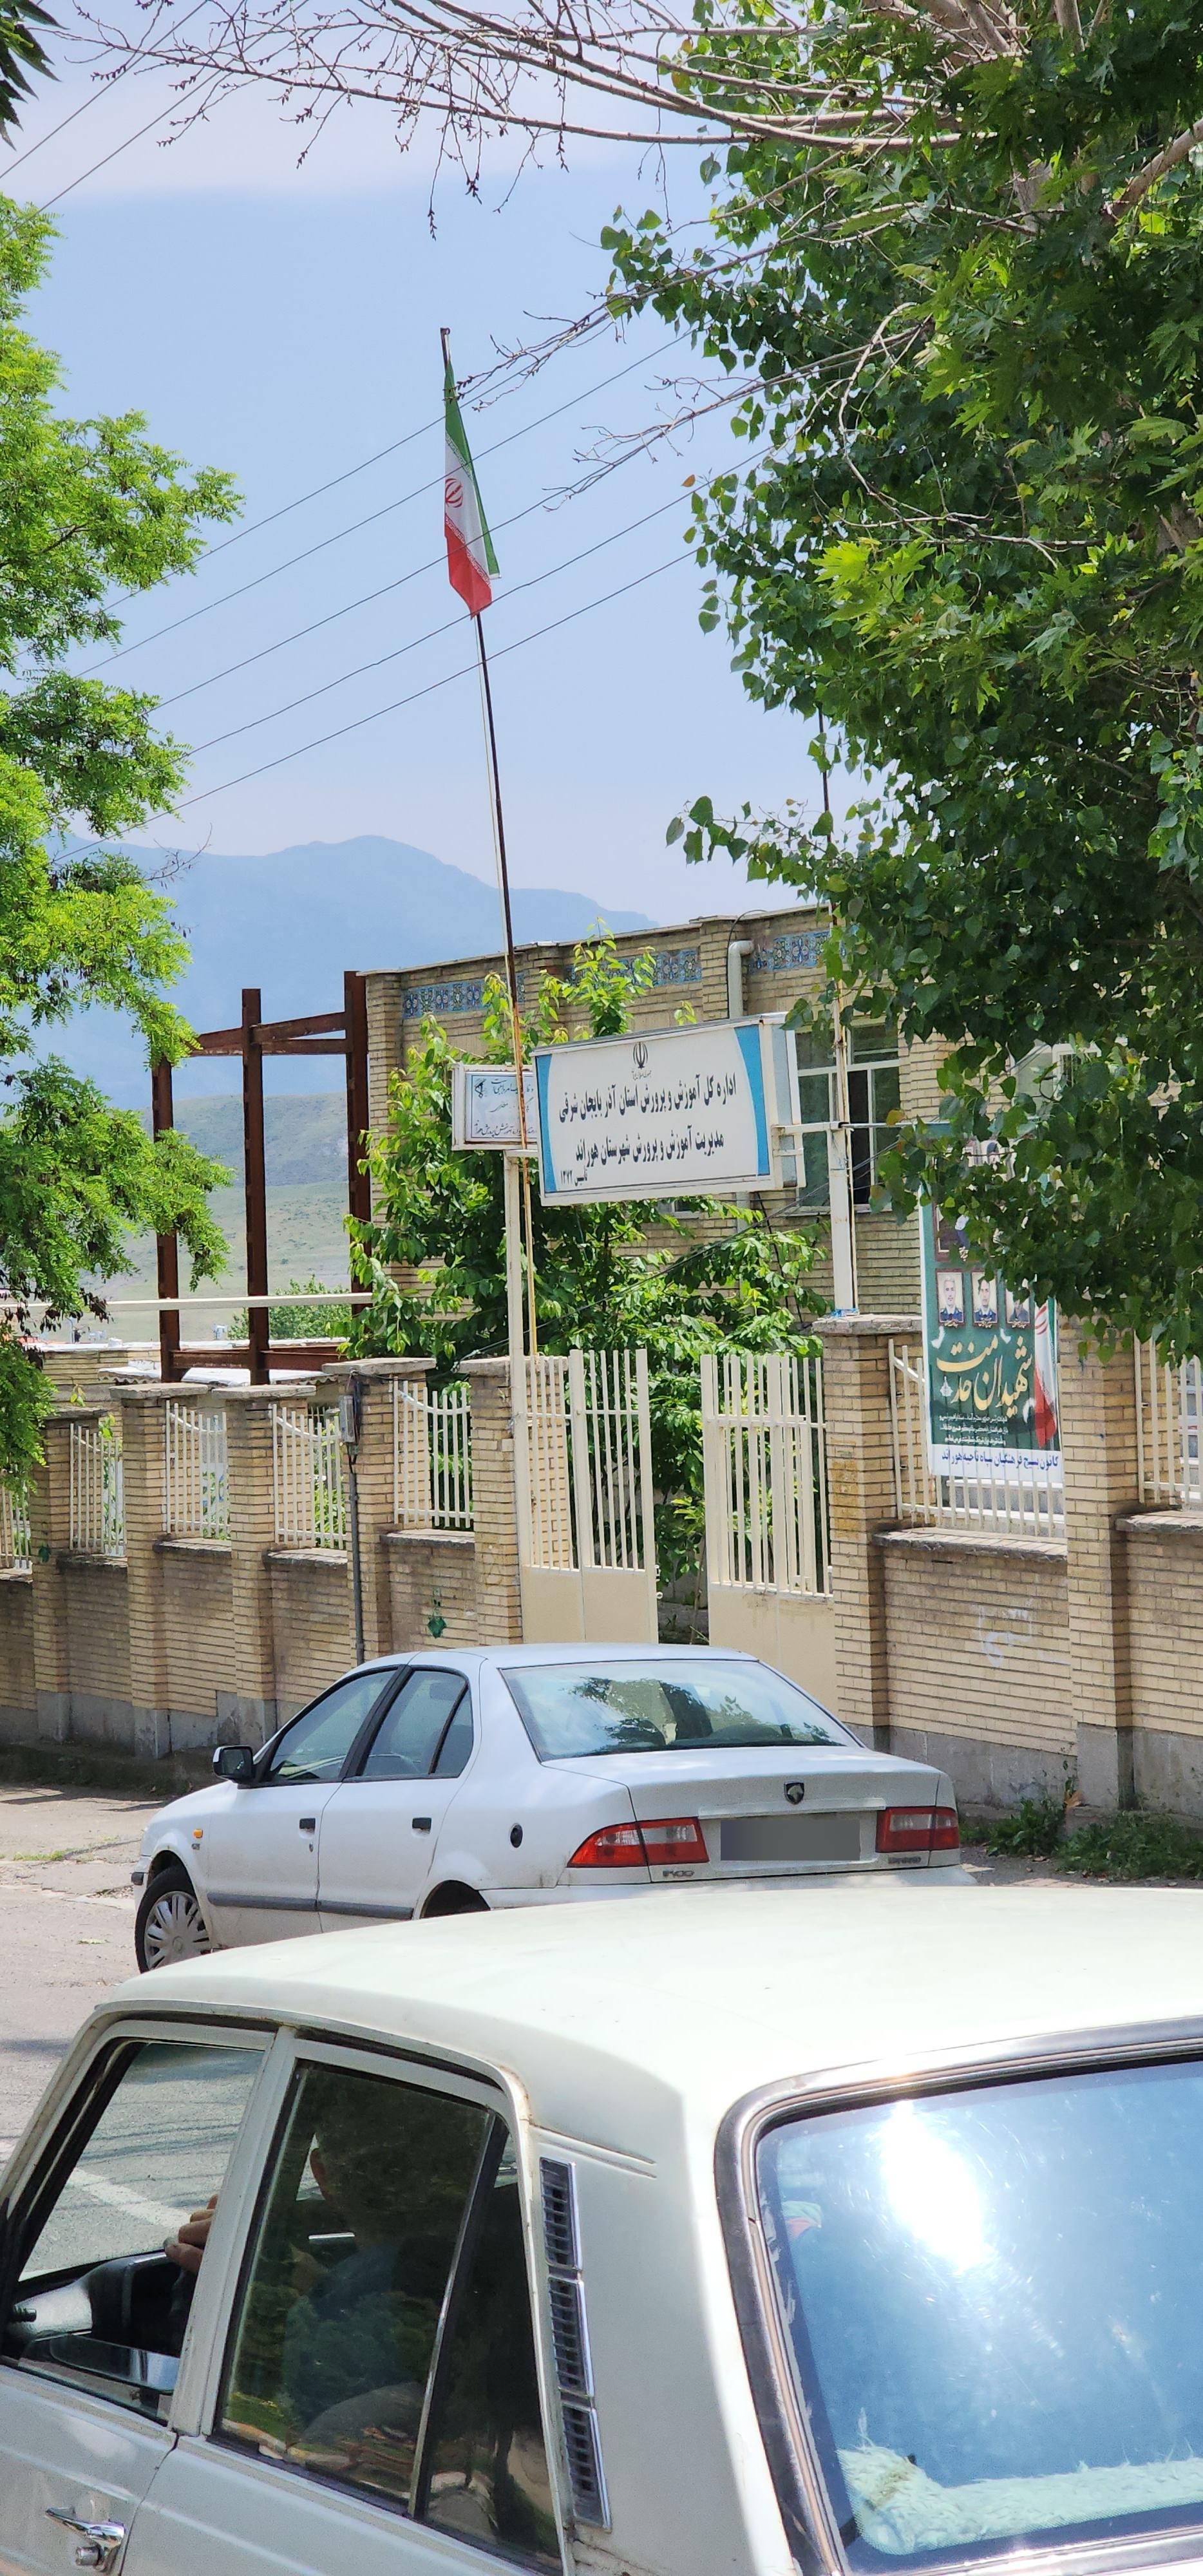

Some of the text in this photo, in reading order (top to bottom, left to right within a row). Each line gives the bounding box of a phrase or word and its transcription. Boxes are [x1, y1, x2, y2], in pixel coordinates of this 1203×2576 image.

[619, 1084, 639, 1116] استان
[640, 1083, 667, 1113] پرورش
[668, 1090, 672, 1112] و
[674, 1074, 700, 1110] آموزش
[704, 1075, 714, 1106] کل
[717, 1072, 736, 1105] اداره
[559, 1092, 578, 1123] شرقی
[576, 1124, 724, 1168] مدیریت آموزش و پرورش شهرستان هوراند
[936, 1334, 1032, 1419] شهیدان خدمت
[942, 1448, 963, 1464] هوراند
[980, 1451, 993, 1466] سپاه
[994, 1452, 1022, 1469] فرهنگیان
[1023, 1455, 1039, 1470] بسیج
[1039, 1454, 1059, 1471] کانون
